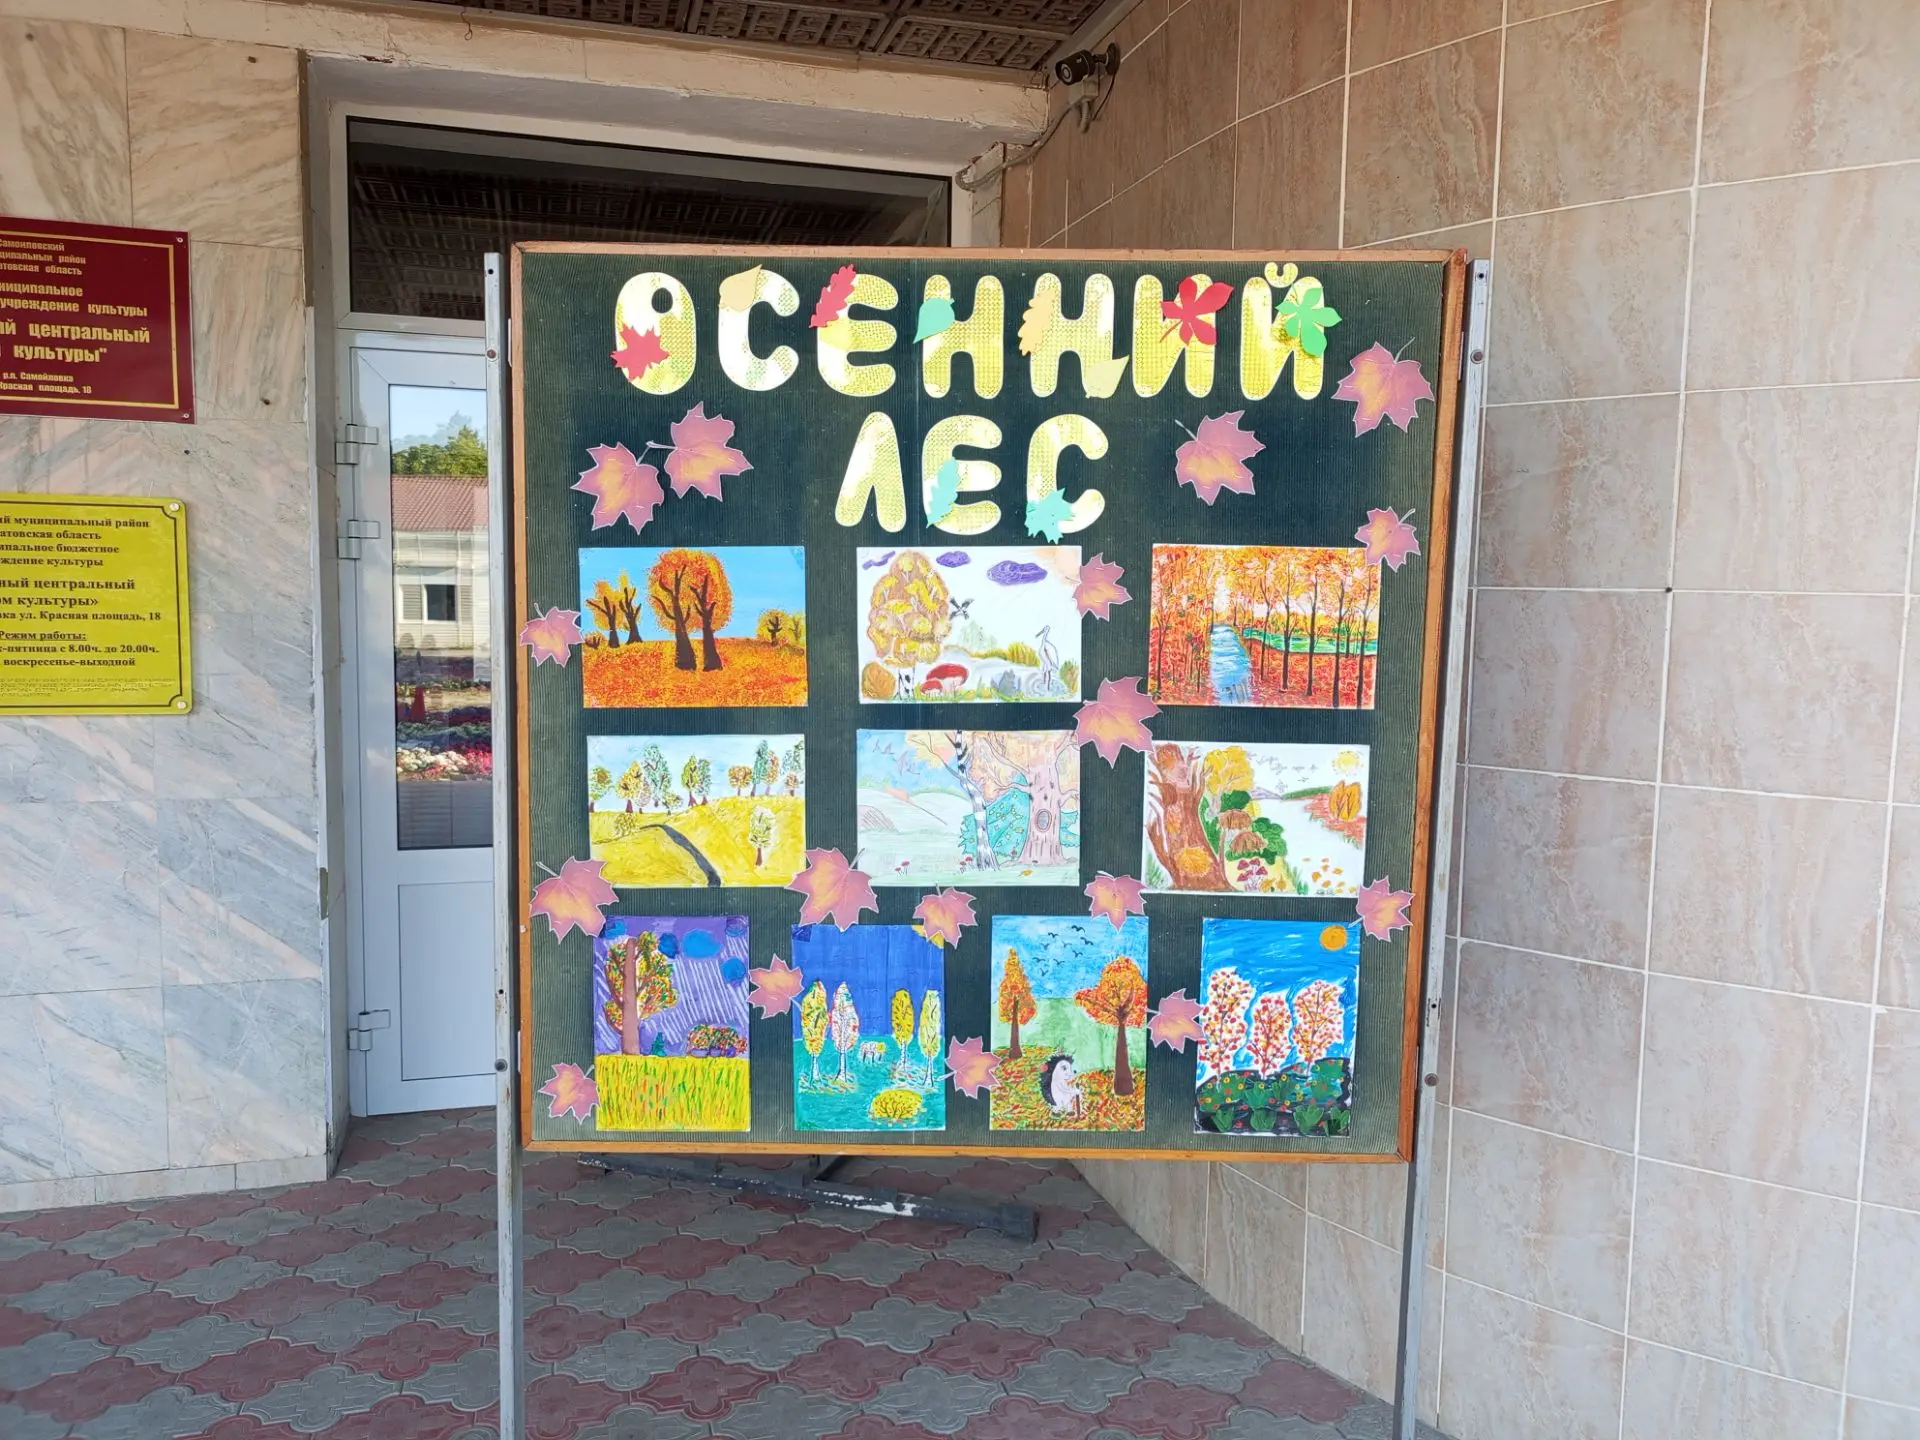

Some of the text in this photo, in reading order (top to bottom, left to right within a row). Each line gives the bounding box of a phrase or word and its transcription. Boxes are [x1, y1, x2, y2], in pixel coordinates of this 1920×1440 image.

[58, 254, 86, 264] район
[45, 265, 83, 275] область
[0, 298, 148, 317] учреждение культуры
[28, 323, 150, 343] центральный
[614, 262, 1324, 401] ОСЕННИЙ
[20, 372, 74, 382] Самойловка
[836, 411, 1106, 534] ЛЕС
[14, 516, 112, 527] муниципальный
[115, 518, 150, 529] район
[56, 530, 101, 540] область
[56, 543, 119, 553] бюджетное
[47, 558, 104, 568] культуры
[34, 579, 135, 591] центральный
[17, 597, 98, 608] культуры»
[19, 612, 36, 621] ул.
[40, 611, 88, 621] Красная
[92, 612, 146, 621] площадь,
[149, 612, 161, 620] 18
[40, 631, 86, 641] работы:
[68, 645, 101, 653] 8.00ч.
[3, 657, 136, 668] воскресенье-выходной
